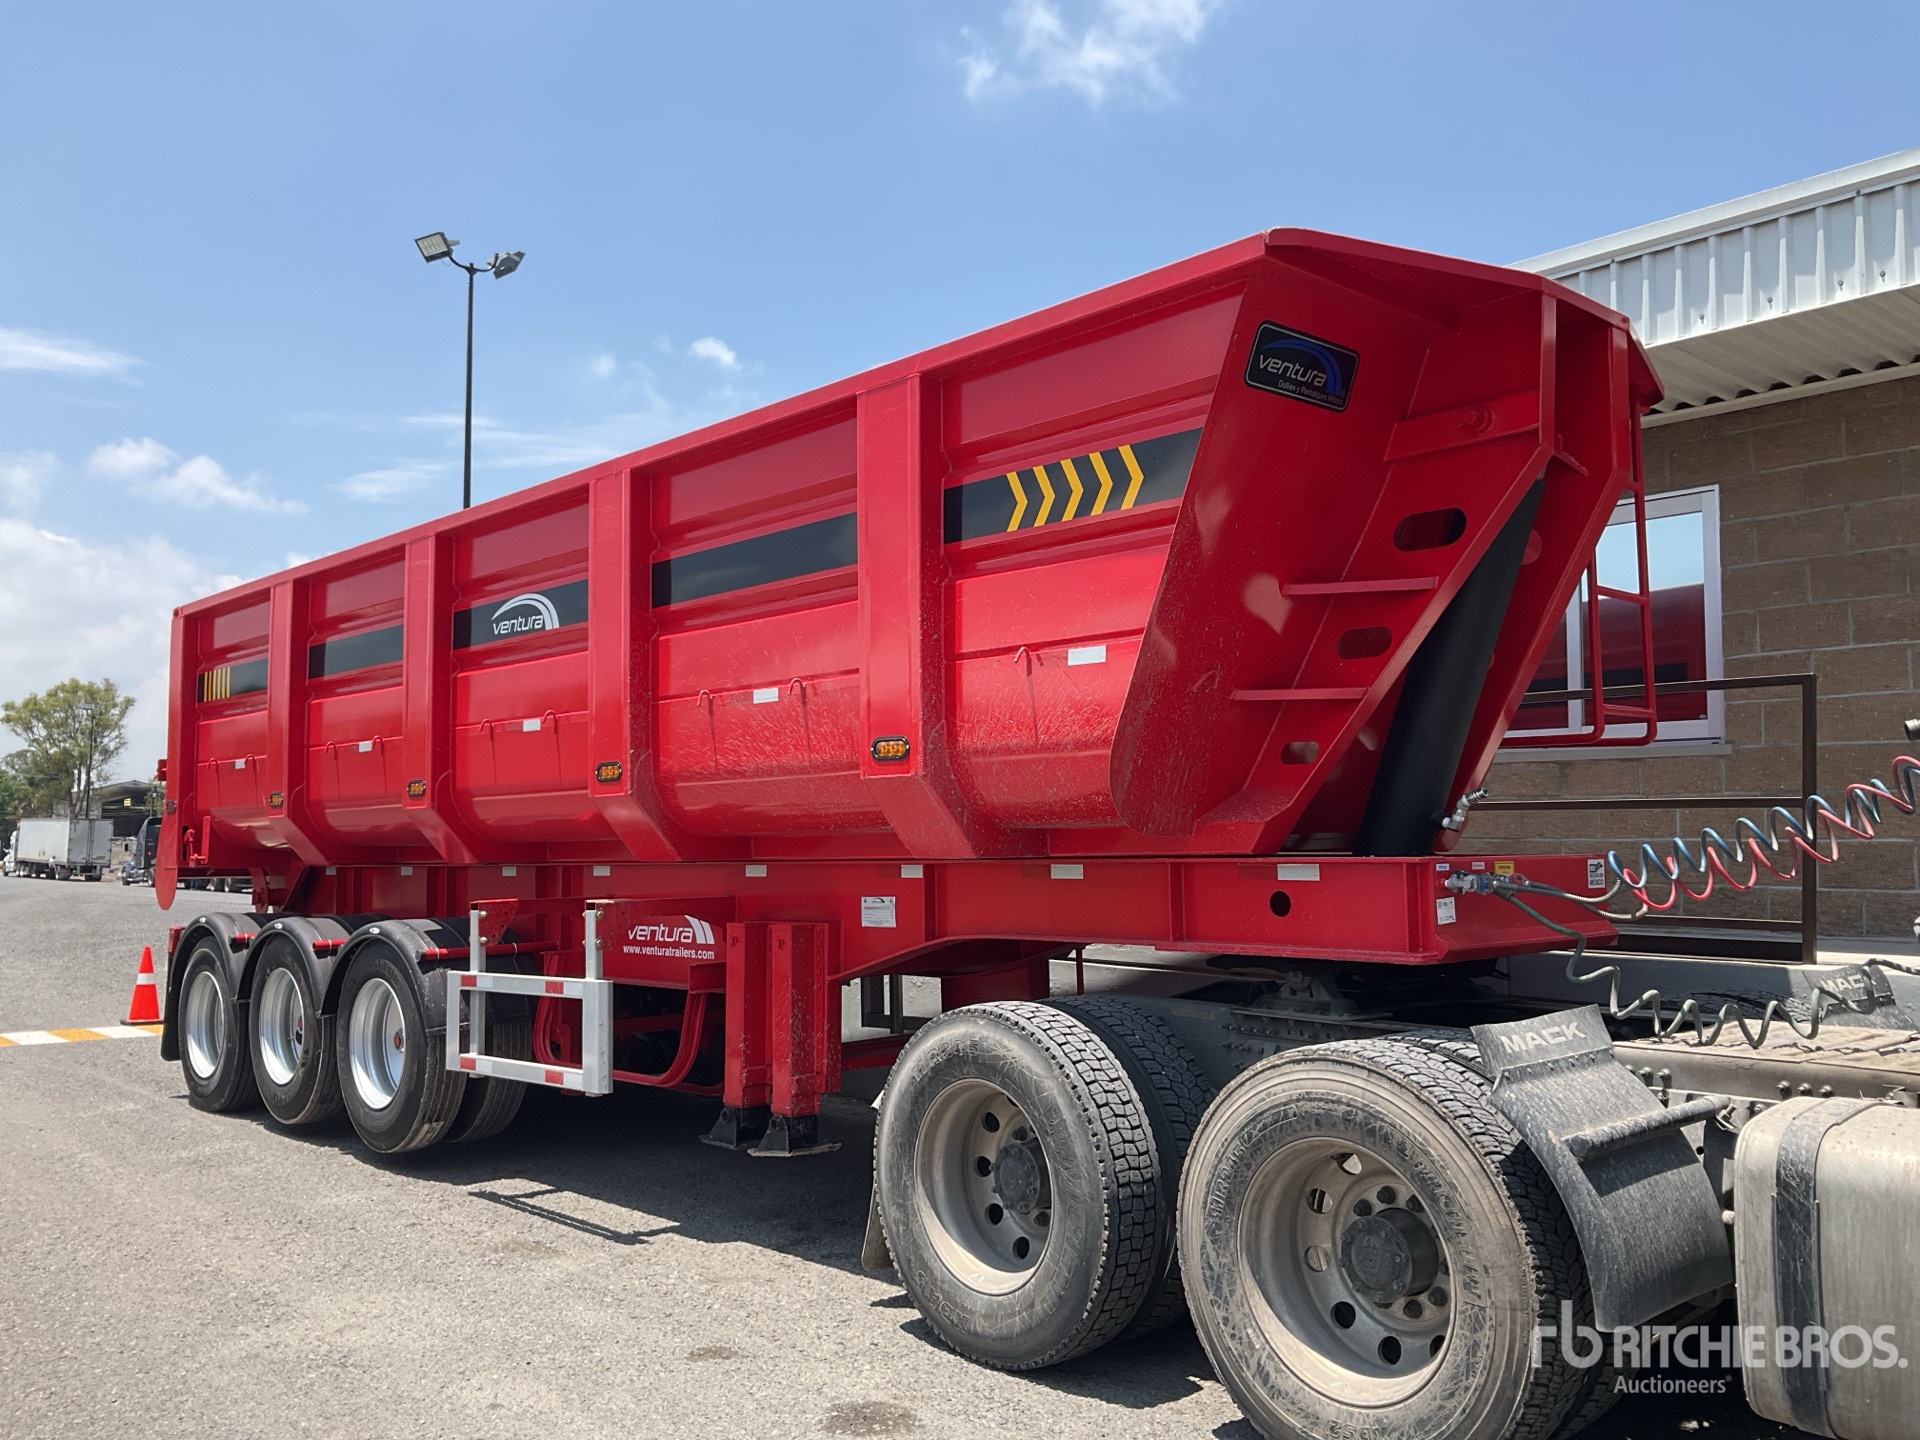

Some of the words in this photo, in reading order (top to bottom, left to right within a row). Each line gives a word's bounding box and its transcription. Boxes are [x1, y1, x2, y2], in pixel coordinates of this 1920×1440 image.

[1259, 354, 1327, 387] ventura
[493, 614, 544, 635] ventura
[628, 923, 694, 943] ventura
[623, 945, 715, 959] www.venturatrailers.com
[1820, 972, 1877, 992] MAC
[1499, 1021, 1587, 1053] MACK
